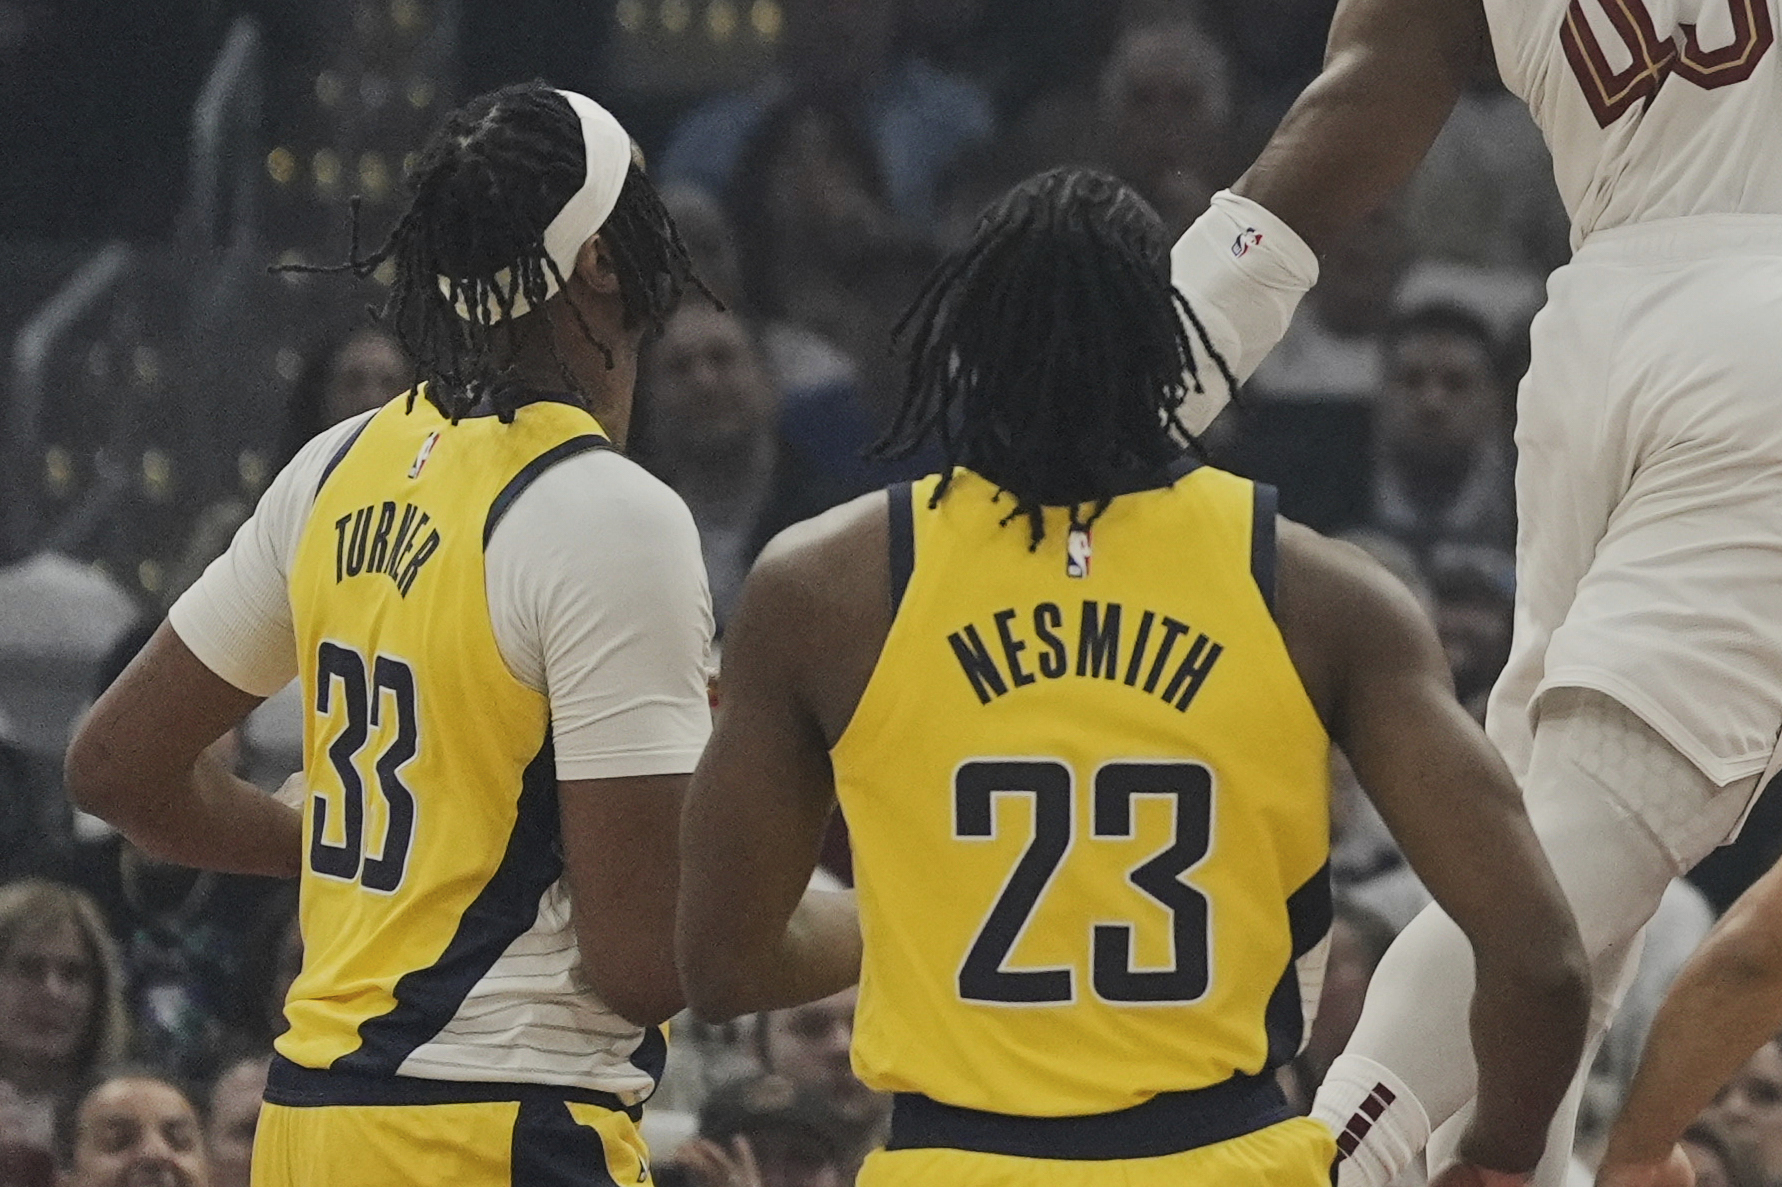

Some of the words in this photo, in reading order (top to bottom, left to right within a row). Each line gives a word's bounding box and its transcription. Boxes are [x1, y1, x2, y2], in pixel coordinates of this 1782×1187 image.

[334, 501, 443, 600] TURNER
[947, 600, 1224, 714] NESMITH
[308, 638, 420, 897] 33
[951, 755, 1216, 1009] 23
